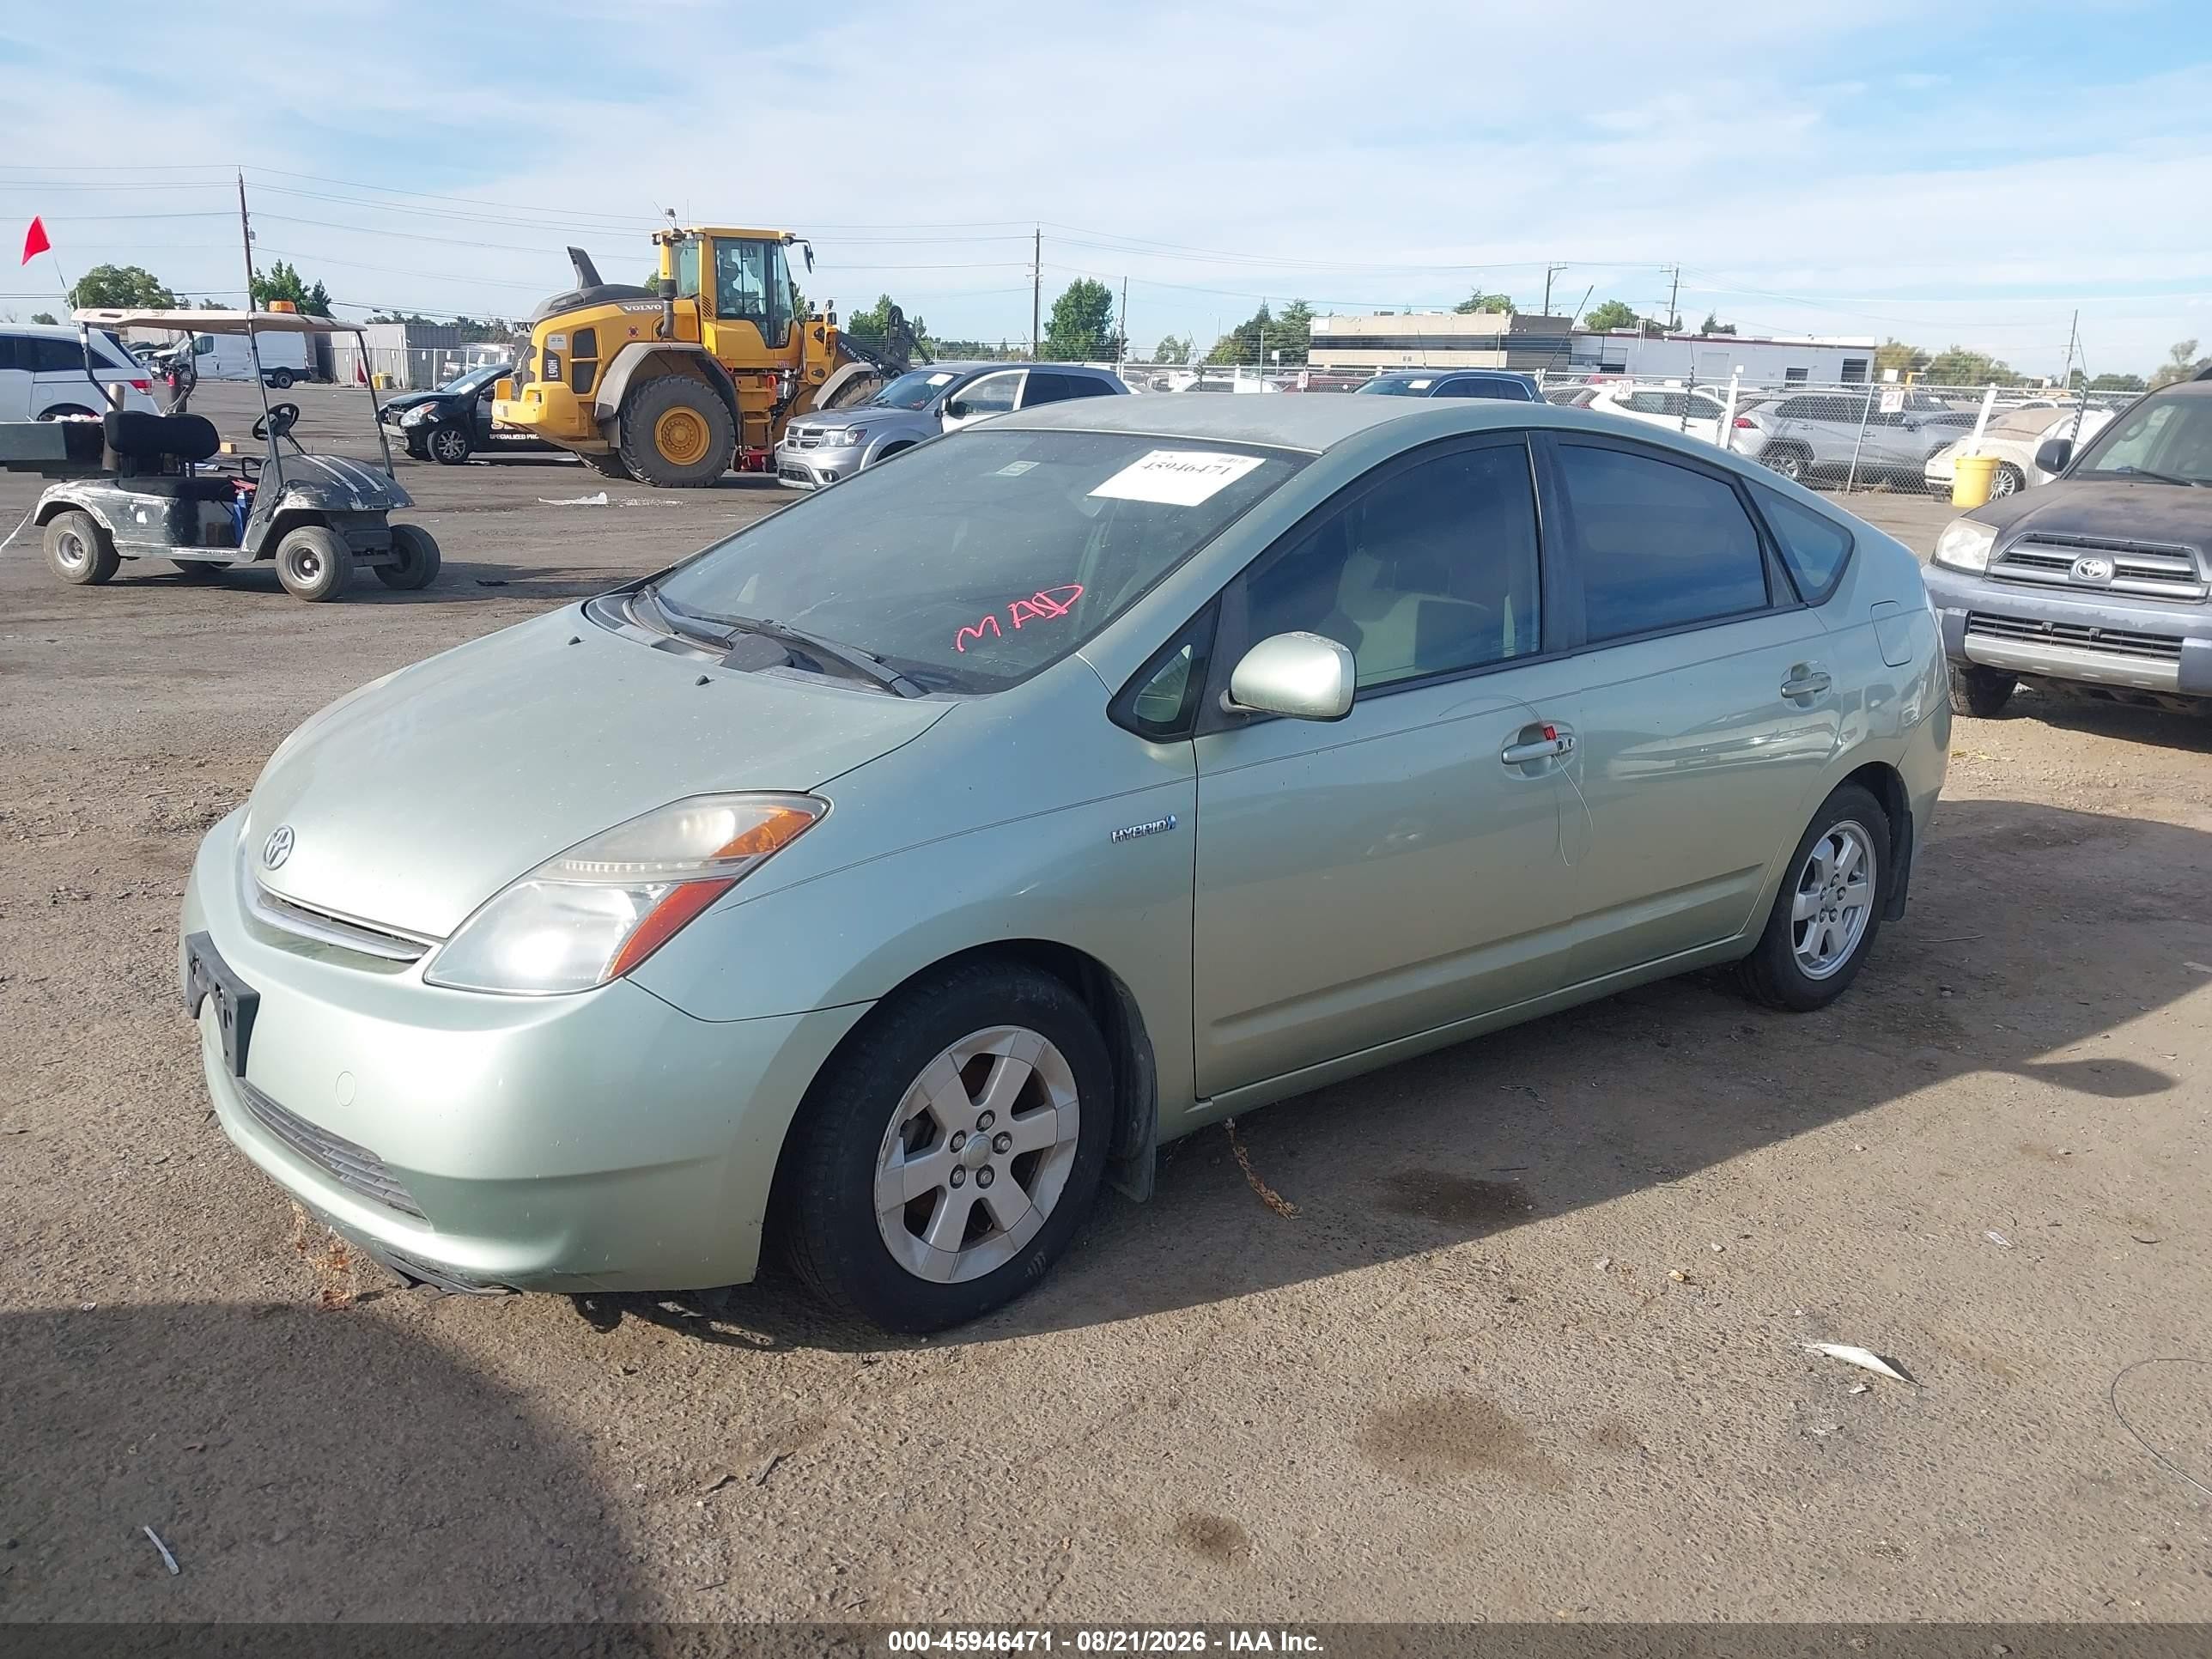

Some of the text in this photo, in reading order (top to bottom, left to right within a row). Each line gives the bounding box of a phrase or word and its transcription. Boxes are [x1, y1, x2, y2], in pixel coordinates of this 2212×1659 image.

[547, 359, 559, 378] L90H
[1618, 381, 1631, 394] 20
[1884, 392, 1901, 406] 21
[1111, 818, 1167, 843] HYBRID
